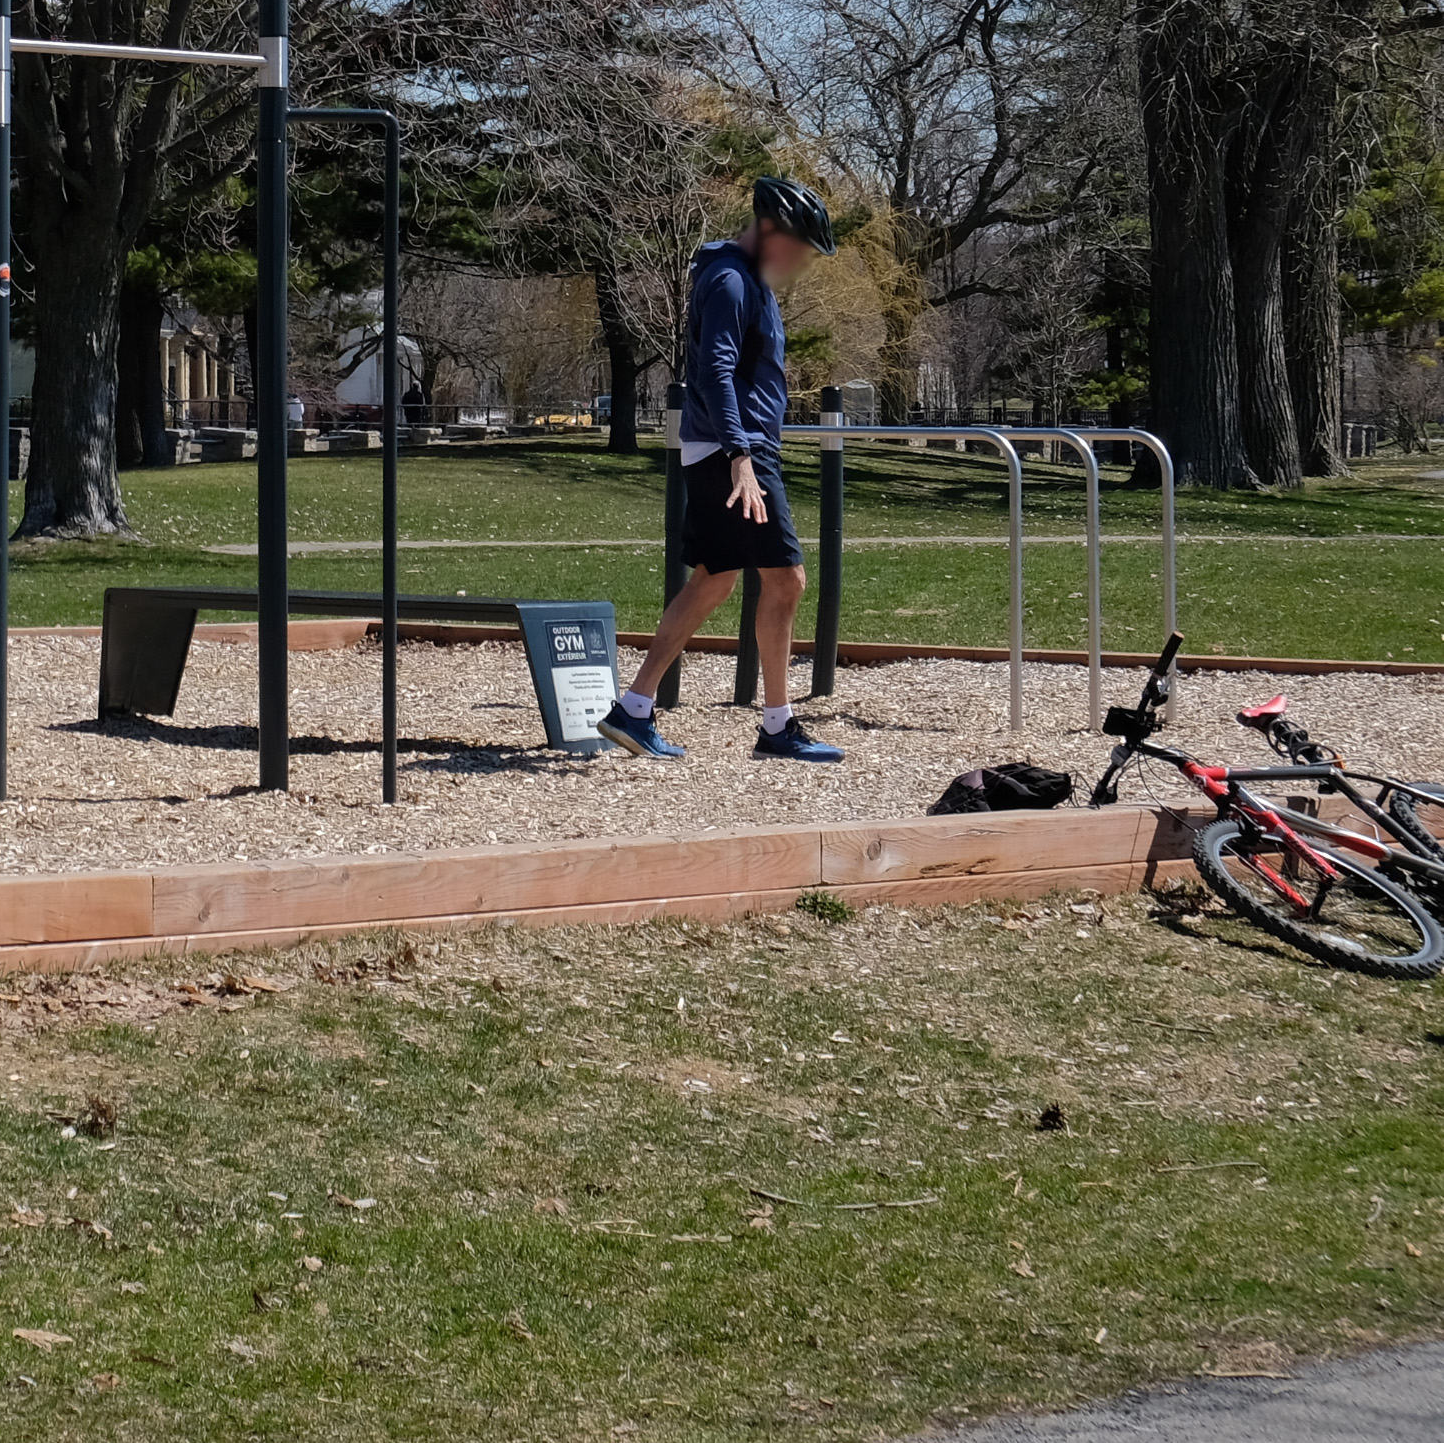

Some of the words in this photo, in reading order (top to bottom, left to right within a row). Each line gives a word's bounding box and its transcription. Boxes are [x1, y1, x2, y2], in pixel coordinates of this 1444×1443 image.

[553, 626, 580, 634] OUTDOOR
[554, 635, 584, 651] GYM
[557, 652, 586, 661] EXTÉRIEUR
